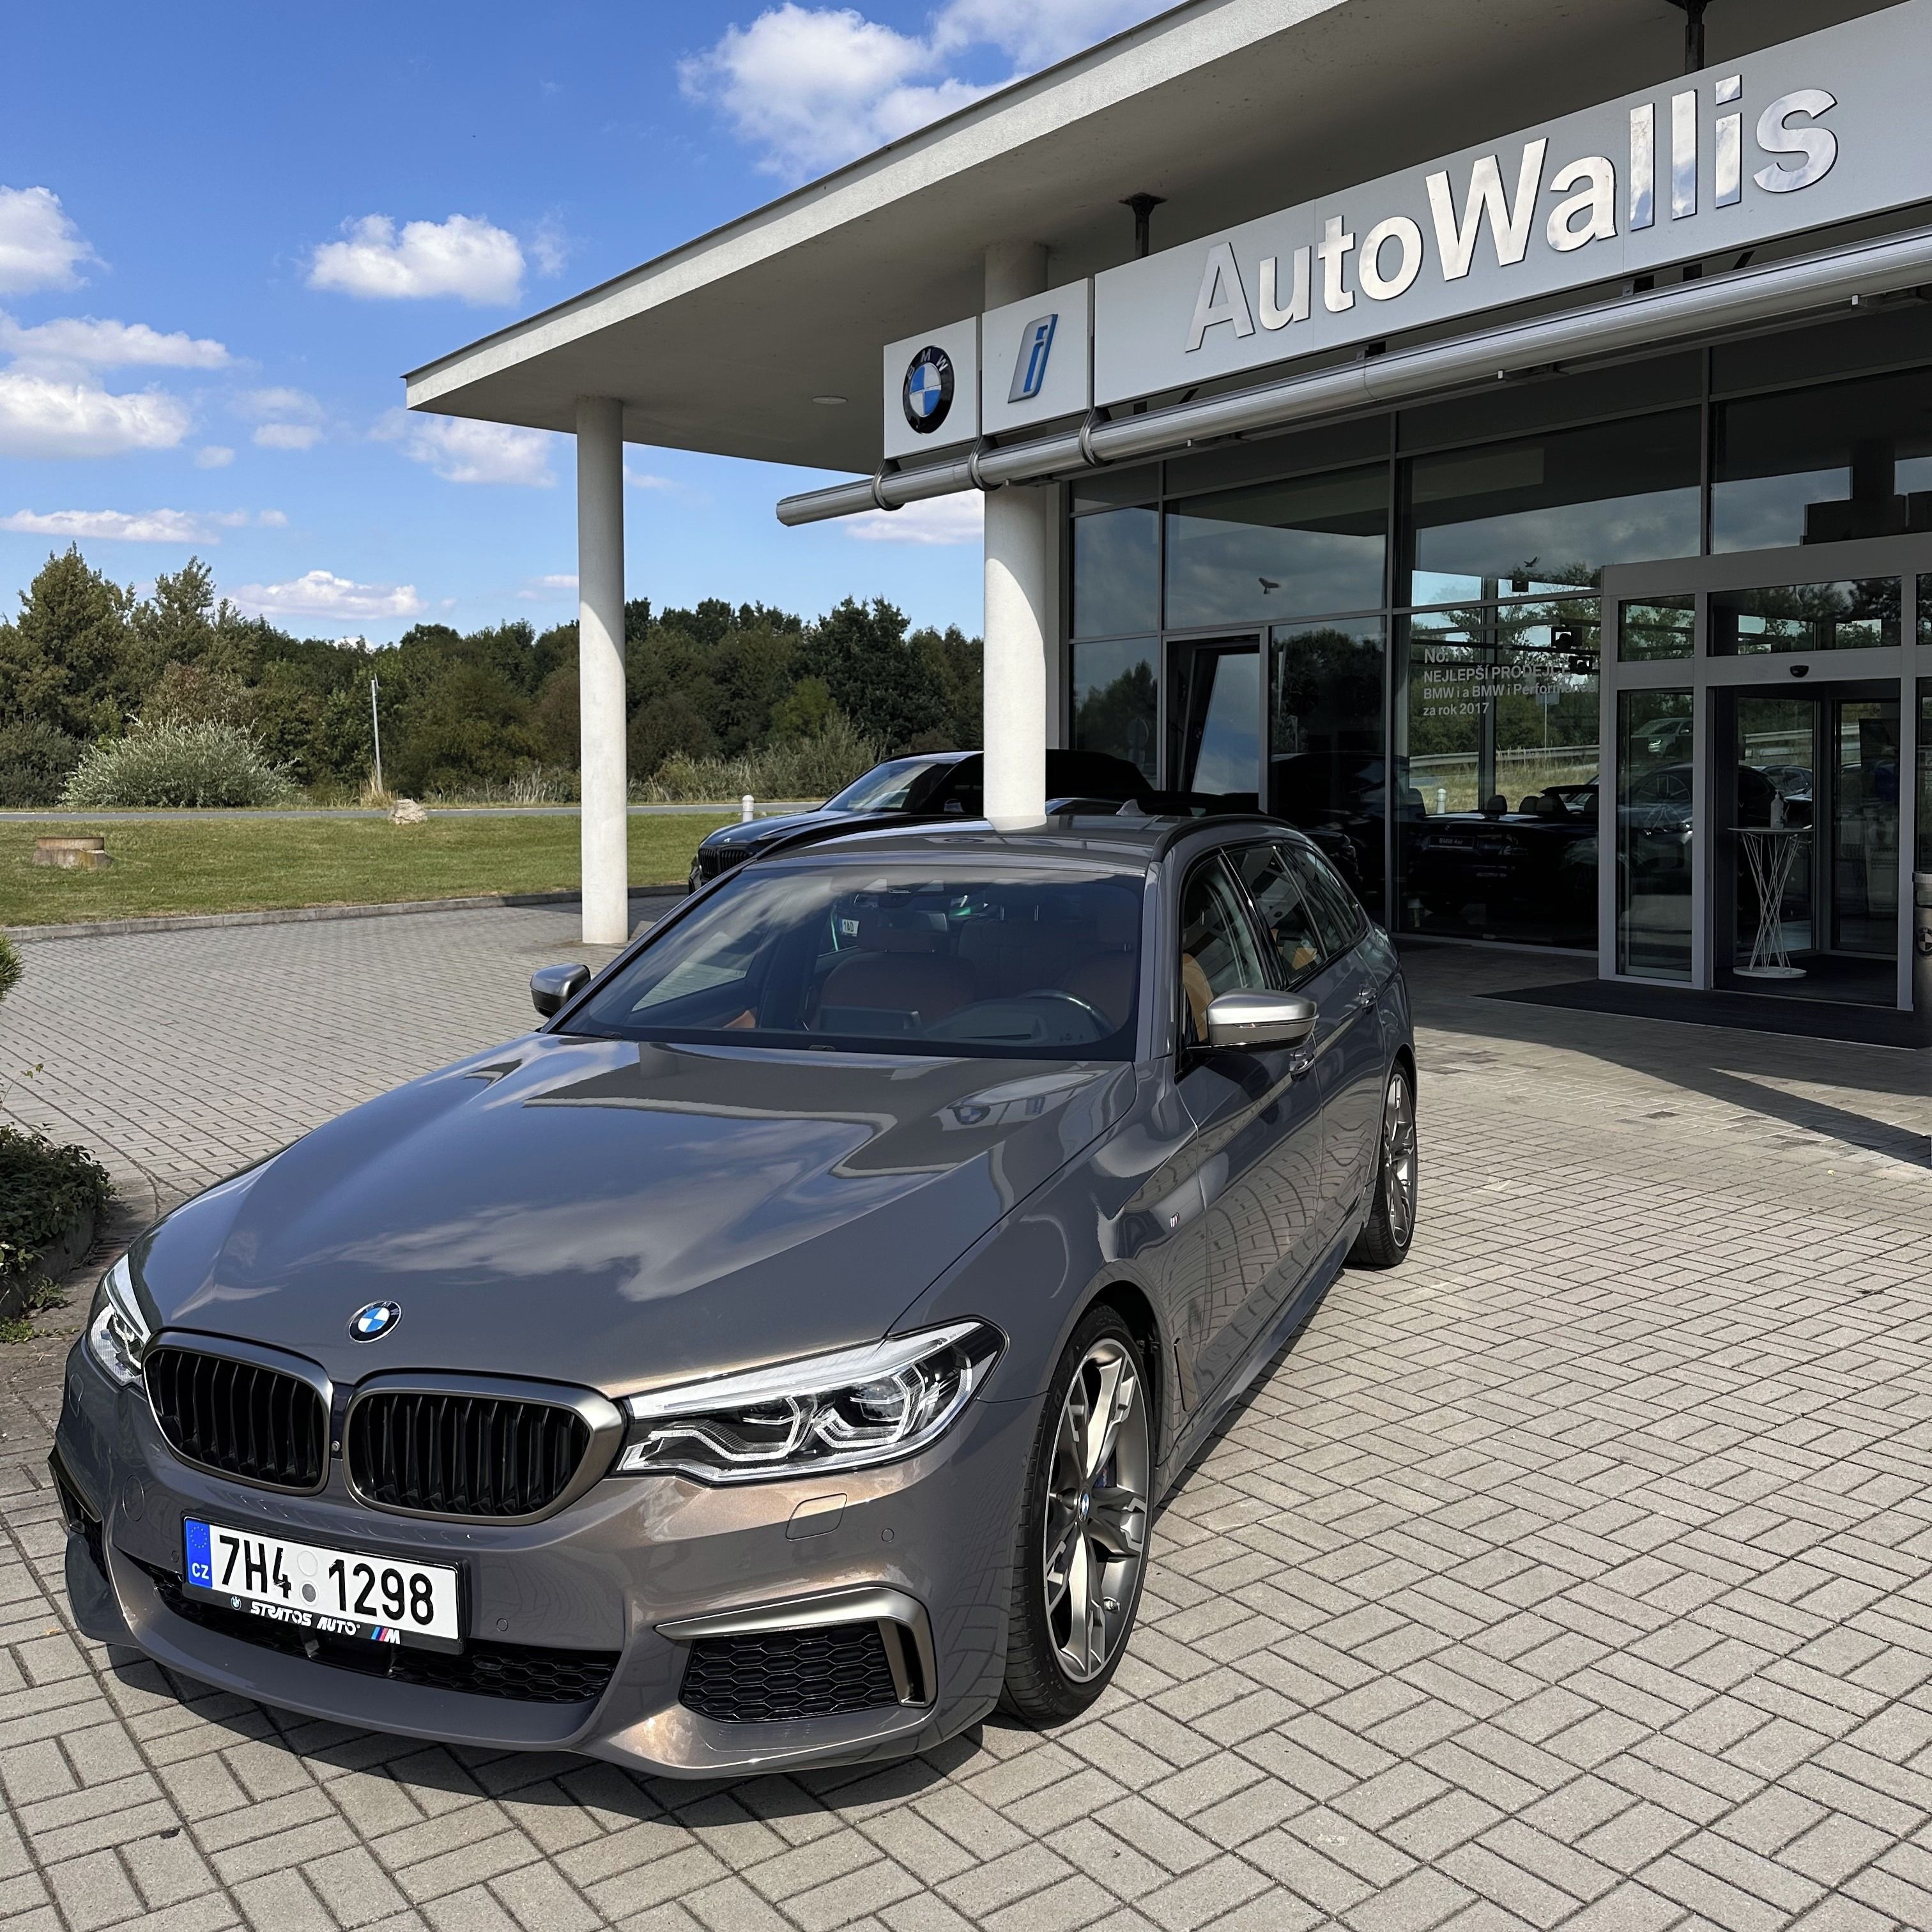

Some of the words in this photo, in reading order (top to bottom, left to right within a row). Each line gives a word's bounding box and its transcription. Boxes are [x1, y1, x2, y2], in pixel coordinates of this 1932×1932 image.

[1185, 74, 1838, 352] AutoWallis
[906, 348, 949, 379] BMW
[1424, 648, 1449, 664] No.
[1423, 664, 1490, 683] NEJLEPŠÍ
[1423, 686, 1454, 700] BMW
[1457, 686, 1460, 698] i
[1462, 688, 1469, 698] a
[1472, 684, 1505, 698] BMW
[1507, 684, 1511, 695] i
[1423, 707, 1436, 716] za
[1438, 704, 1457, 716] rok
[1459, 702, 1490, 715] 2017
[192, 1563, 210, 1580] CZ
[219, 1534, 291, 1599] 7H4
[328, 1559, 433, 1625] 1298
[250, 1601, 312, 1627] STRATOS
